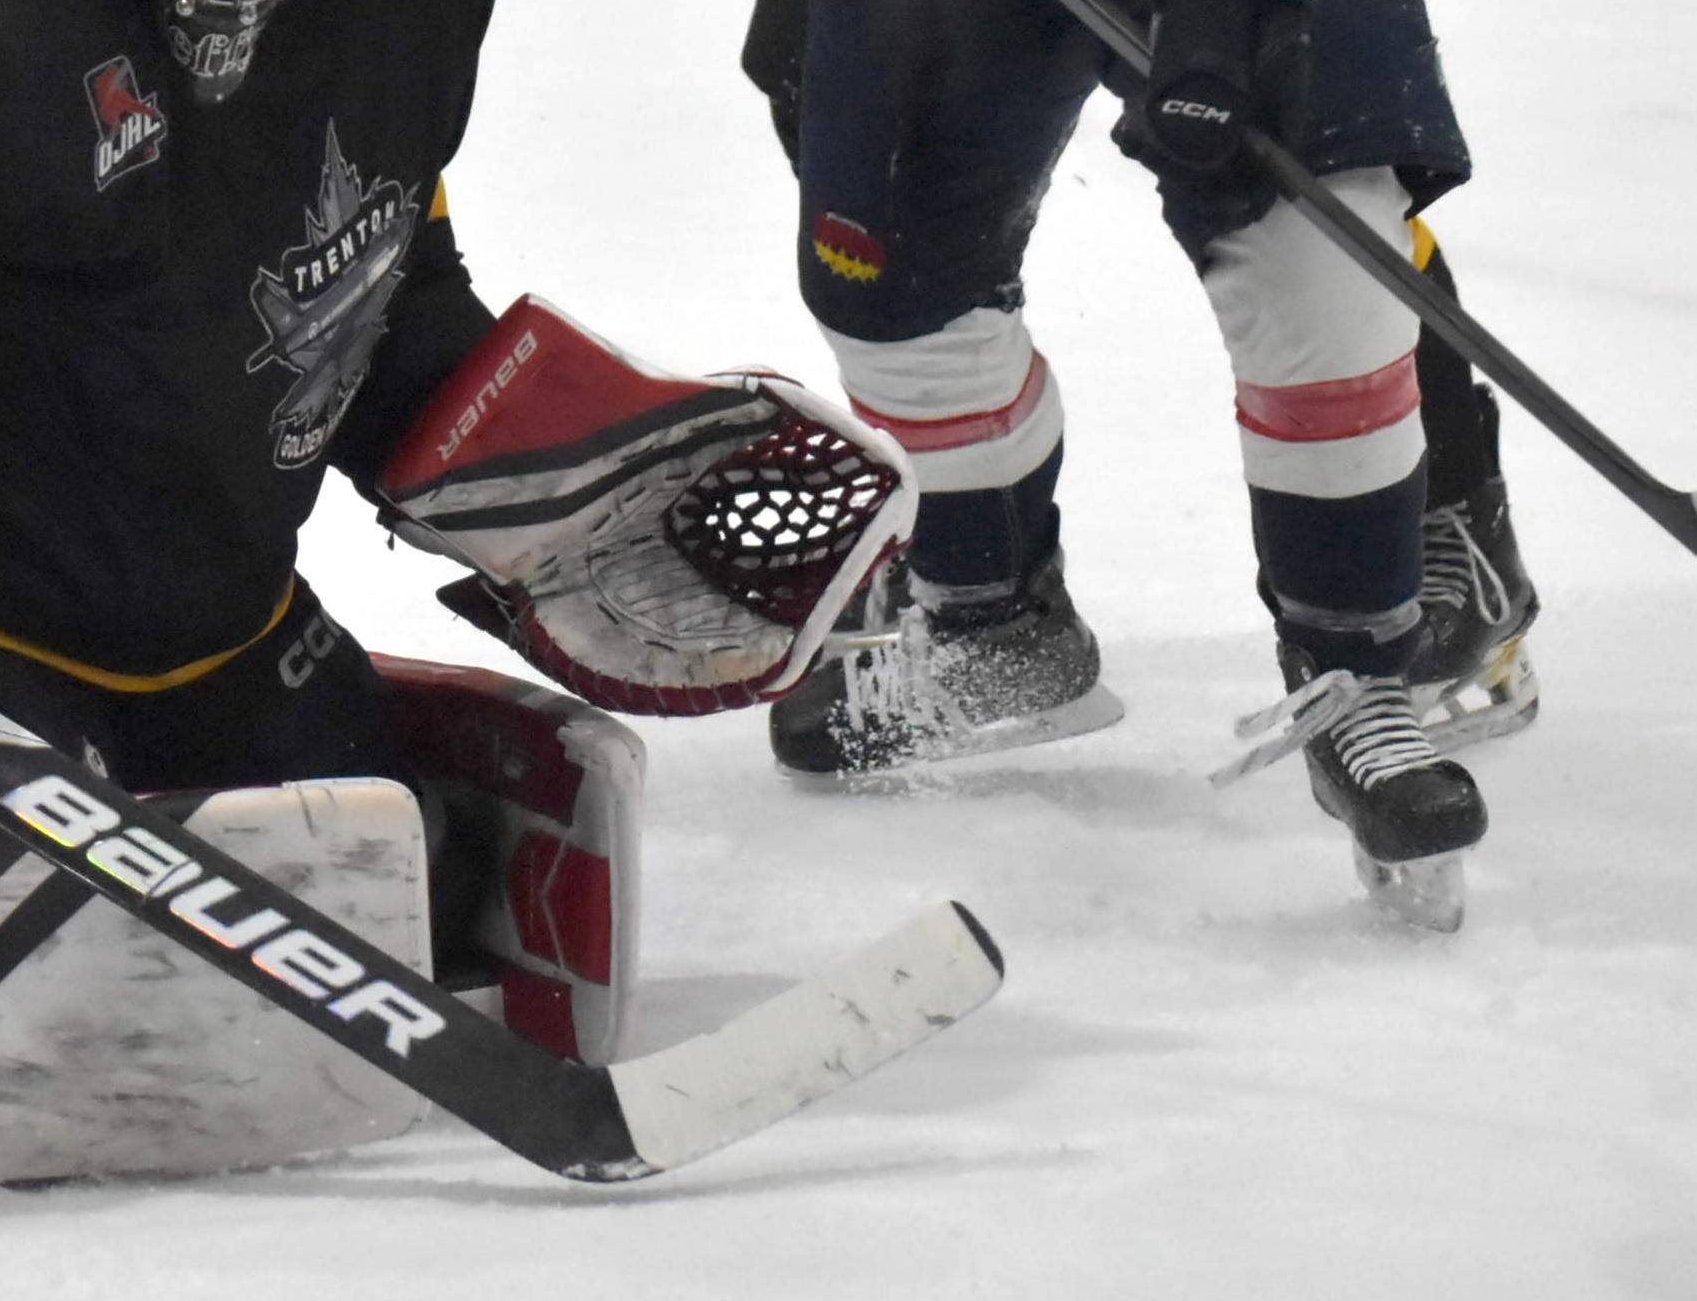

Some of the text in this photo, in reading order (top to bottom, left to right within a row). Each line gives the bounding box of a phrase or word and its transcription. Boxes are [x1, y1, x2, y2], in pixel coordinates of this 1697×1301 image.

[98, 101, 161, 178] OJHL
[1161, 99, 1231, 124] CCM
[294, 200, 396, 292] TRENTON
[437, 328, 539, 461] BAUER
[2, 774, 447, 1059] BAUER
